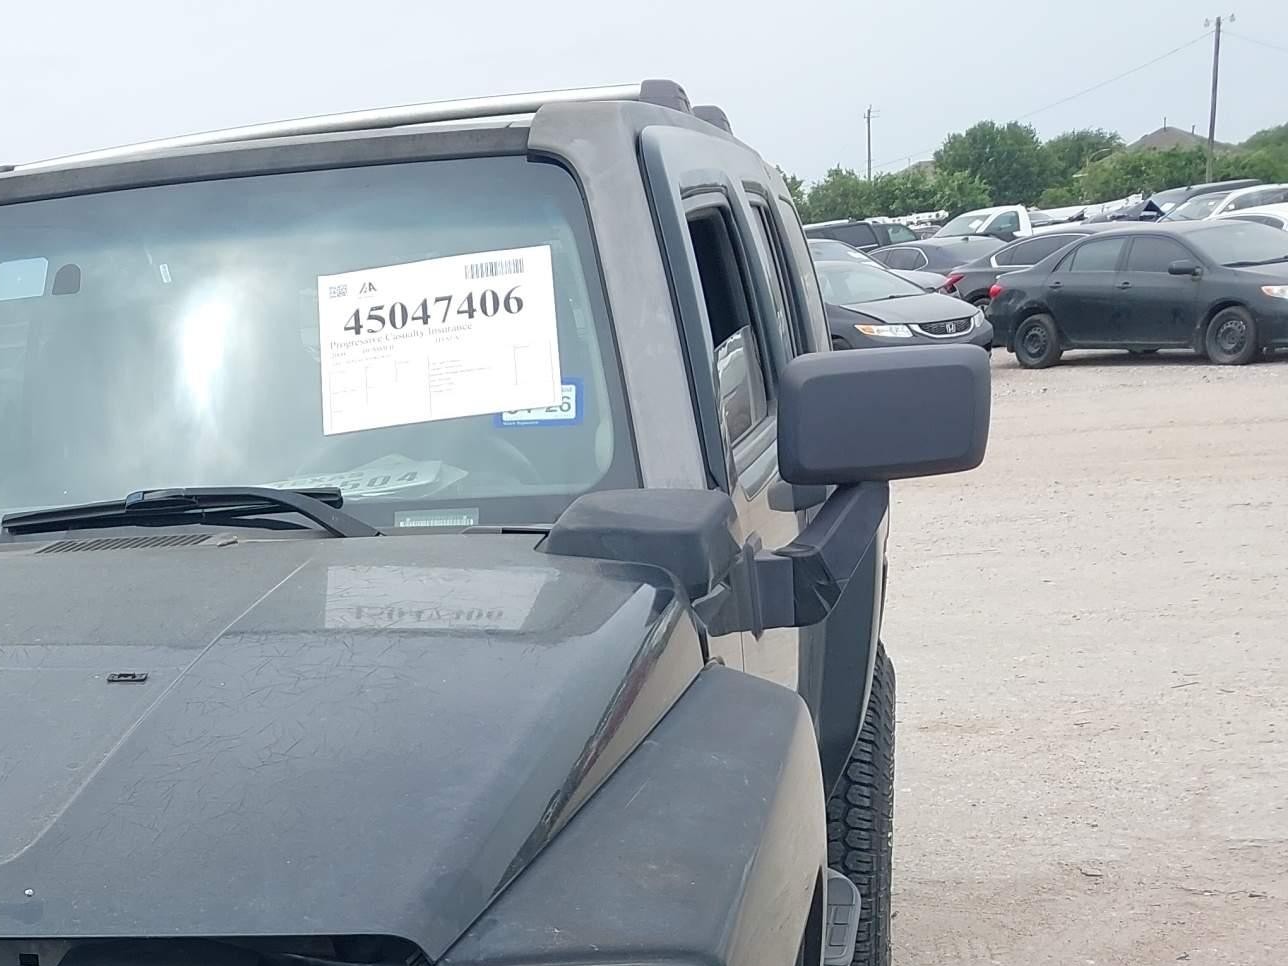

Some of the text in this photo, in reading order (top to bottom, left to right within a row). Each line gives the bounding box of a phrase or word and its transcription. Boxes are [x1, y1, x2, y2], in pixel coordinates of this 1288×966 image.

[343, 284, 525, 336] 45047406
[329, 336, 382, 350] Progressive
[385, 329, 424, 342] Casualty
[428, 323, 473, 336] Insurance
